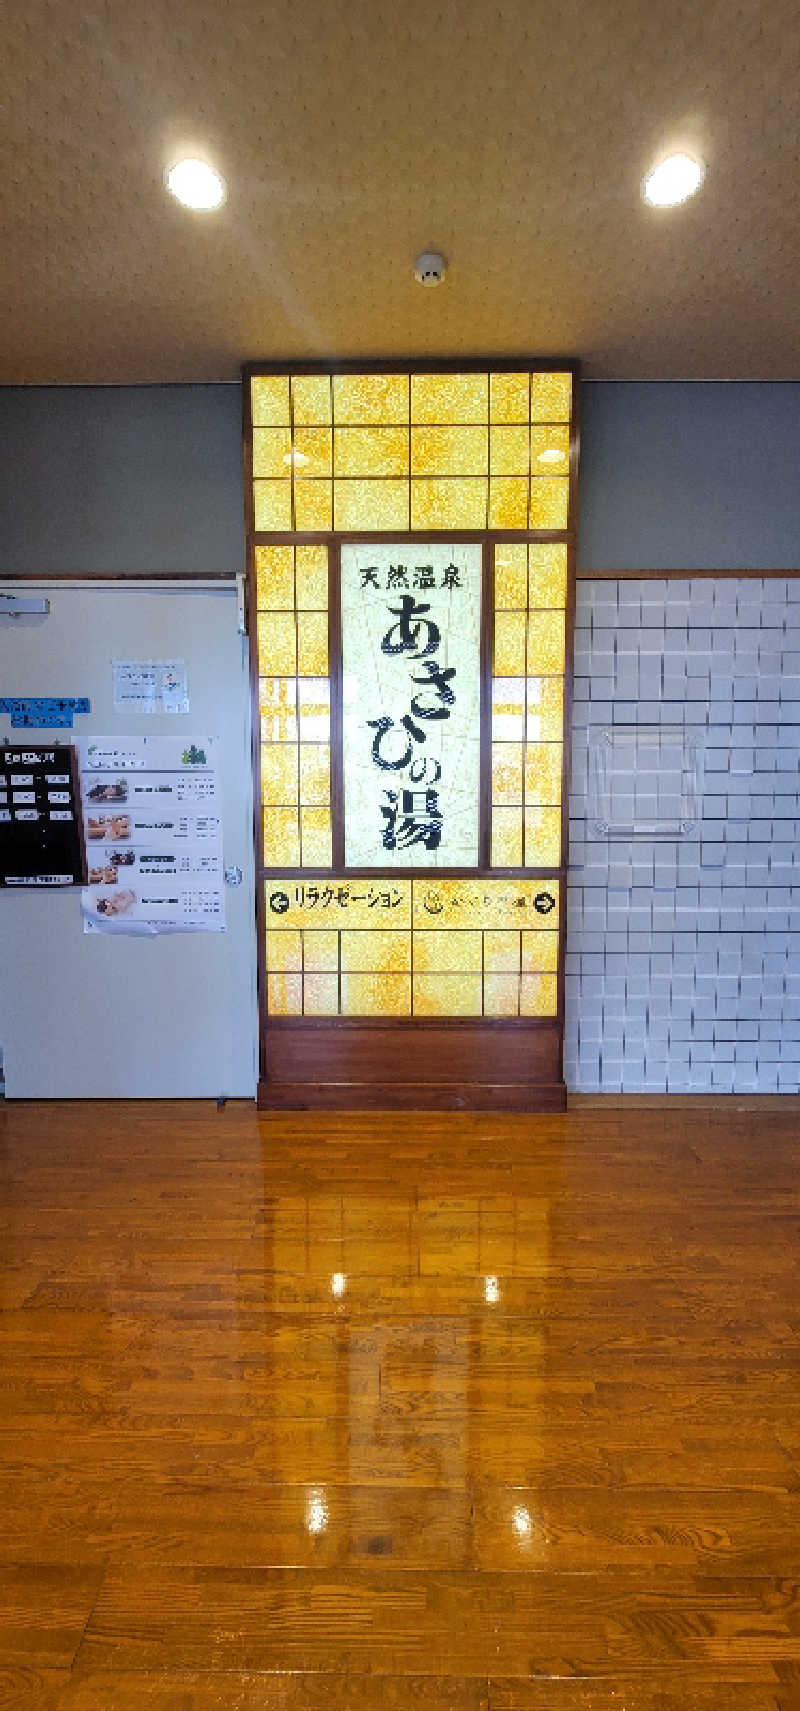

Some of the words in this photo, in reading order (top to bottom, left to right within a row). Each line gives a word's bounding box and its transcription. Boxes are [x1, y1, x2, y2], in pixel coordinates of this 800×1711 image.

[360, 564, 463, 589] 天然温泉
[366, 594, 457, 850] あさひの湯
[295, 885, 404, 909] リラクゼーション
